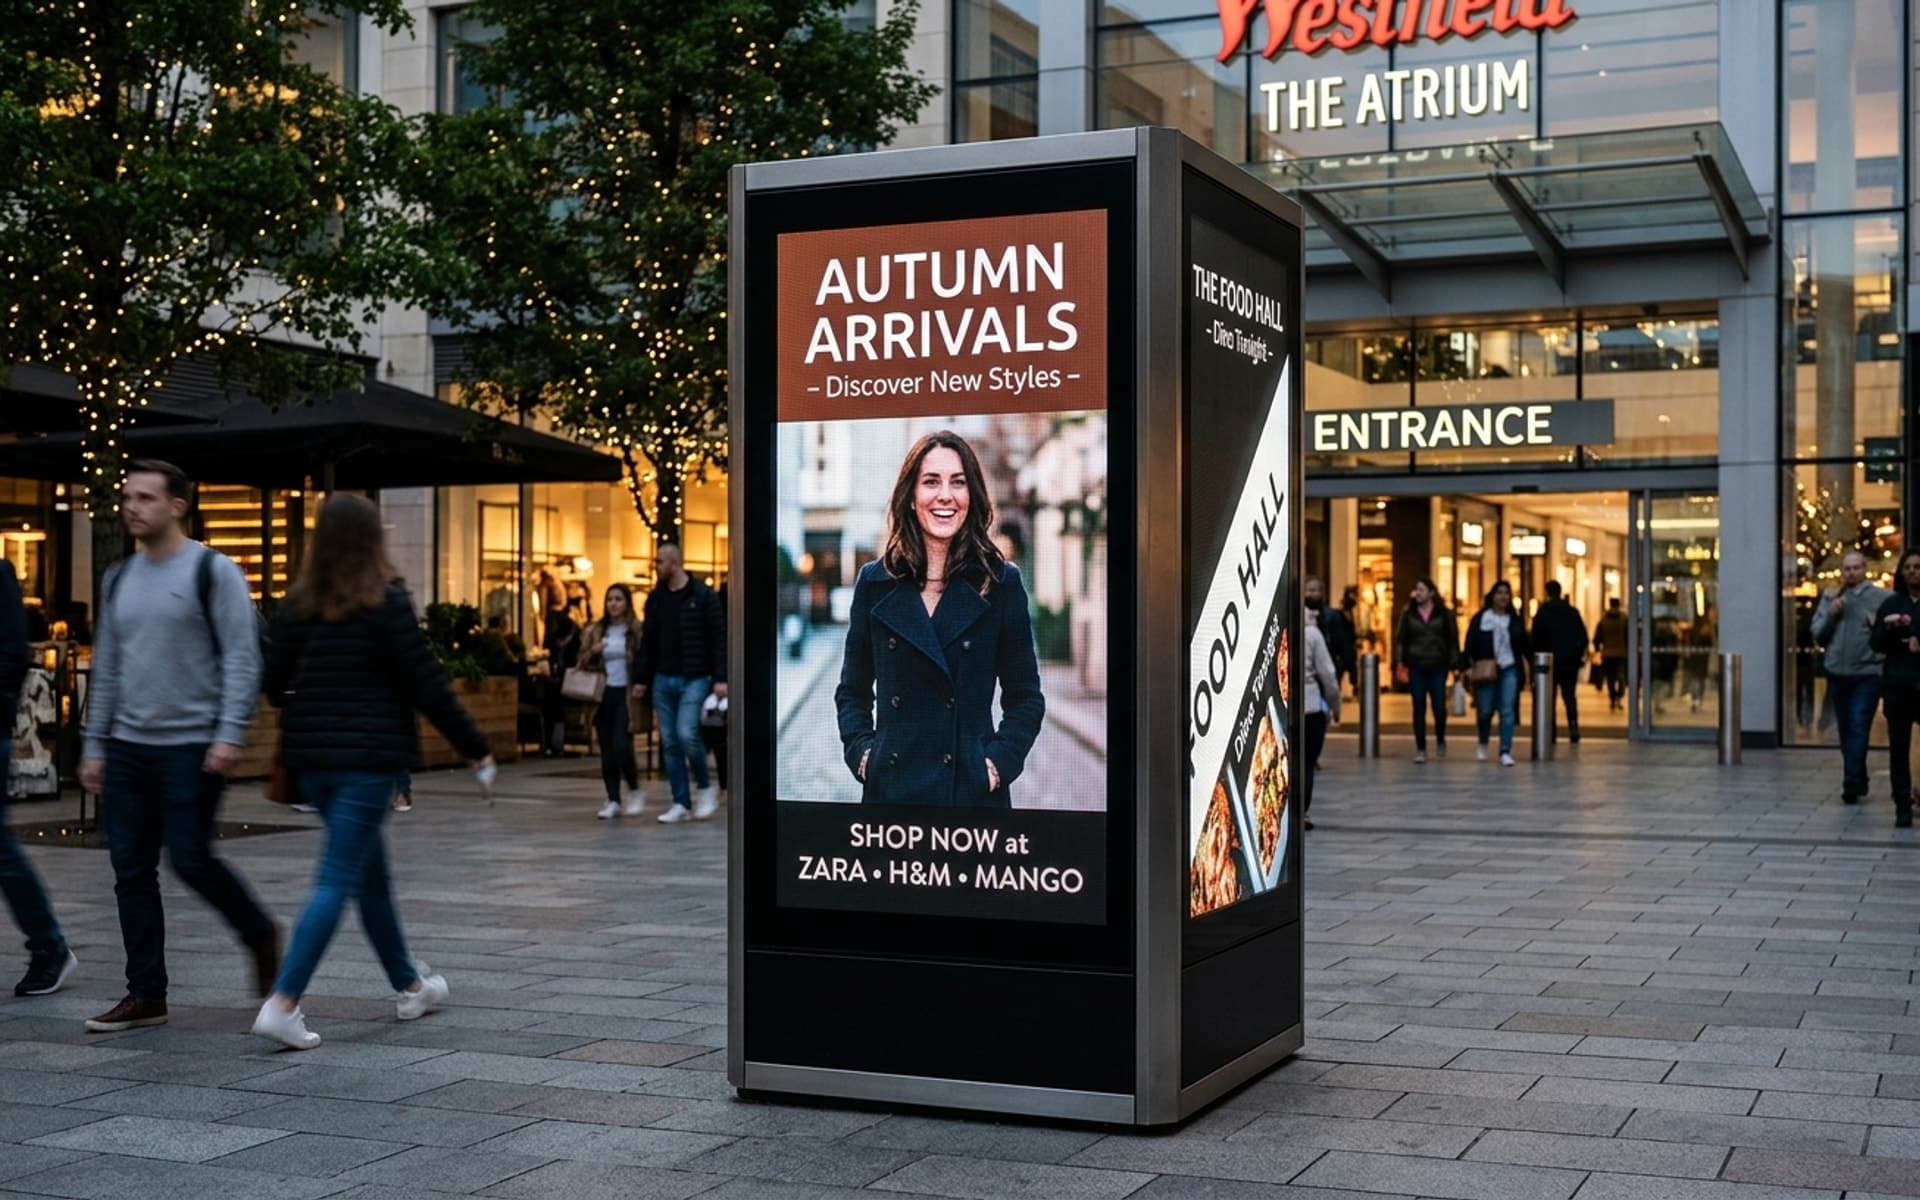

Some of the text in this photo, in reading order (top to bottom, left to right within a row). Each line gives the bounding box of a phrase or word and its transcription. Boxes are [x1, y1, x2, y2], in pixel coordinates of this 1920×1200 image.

[1260, 59, 1526, 131] THE ATRIUM
[815, 242, 1063, 305] AUTUMN
[1193, 264, 1284, 332] THE FOOD HALL
[804, 301, 1078, 364] ARRIVALS
[827, 376, 923, 397] Discover
[931, 370, 982, 392] New
[989, 365, 1060, 394] Styles
[1315, 406, 1552, 450] ENTRANCE
[1238, 472, 1285, 608] HALL
[851, 823, 1029, 854] SHOP NOW at
[799, 856, 867, 882] ZARA
[890, 860, 951, 886] H&M
[975, 864, 1083, 893] MANGO
